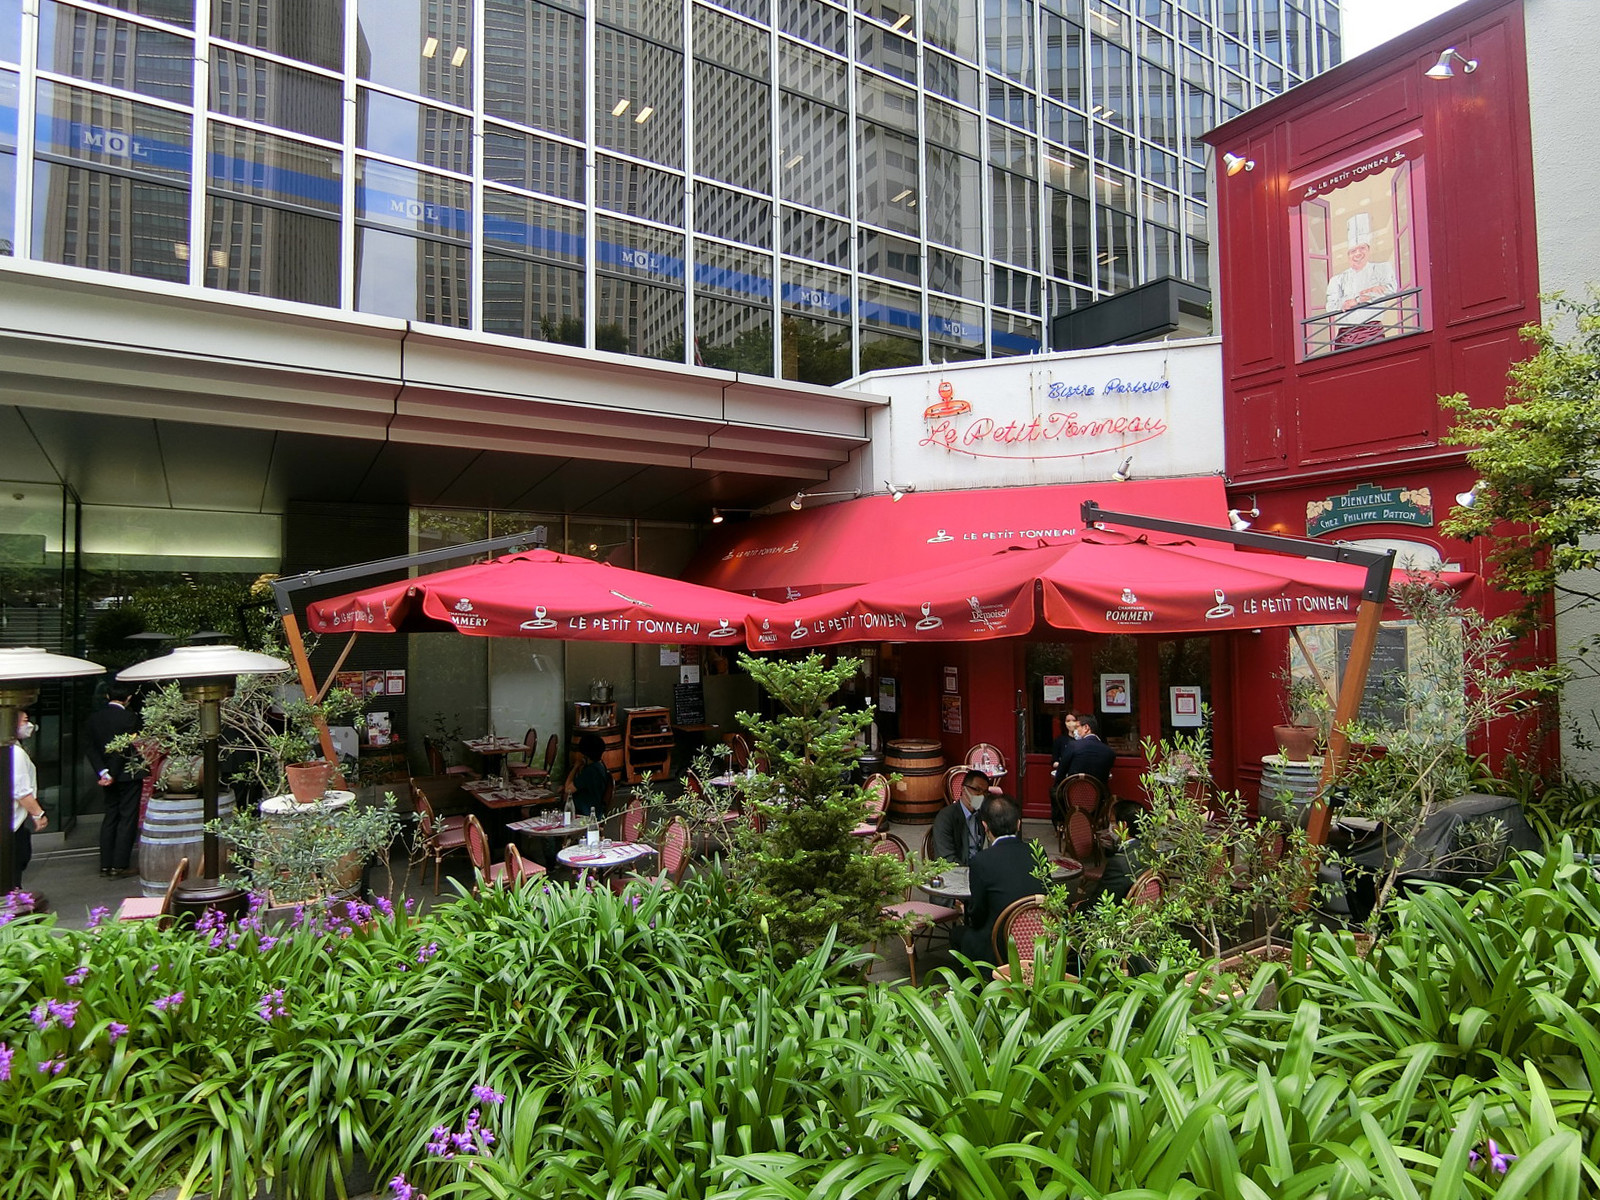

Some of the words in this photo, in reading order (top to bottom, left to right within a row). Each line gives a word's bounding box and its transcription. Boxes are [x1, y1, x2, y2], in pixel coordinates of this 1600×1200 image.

[82, 131, 148, 157] MOL
[1318, 182, 1328, 190] LE
[390, 199, 439, 220] MOL
[622, 251, 660, 270] MOL
[801, 290, 831, 307] MOL
[943, 321, 968, 337] MOL
[918, 420, 958, 446] Le
[963, 417, 1041, 446] Petit
[1043, 412, 1167, 439] Tonneau
[1019, 528, 1076, 539] TONNEAU
[1243, 598, 1258, 614] LE
[1295, 595, 1349, 612] TONNEAU
[451, 615, 489, 627] MMERY
[813, 620, 826, 634] LE
[859, 612, 907, 629] TONNEAU
[1105, 610, 1154, 621] POMMERY
[569, 617, 587, 630] LE
[636, 619, 701, 635] TONNEAU
